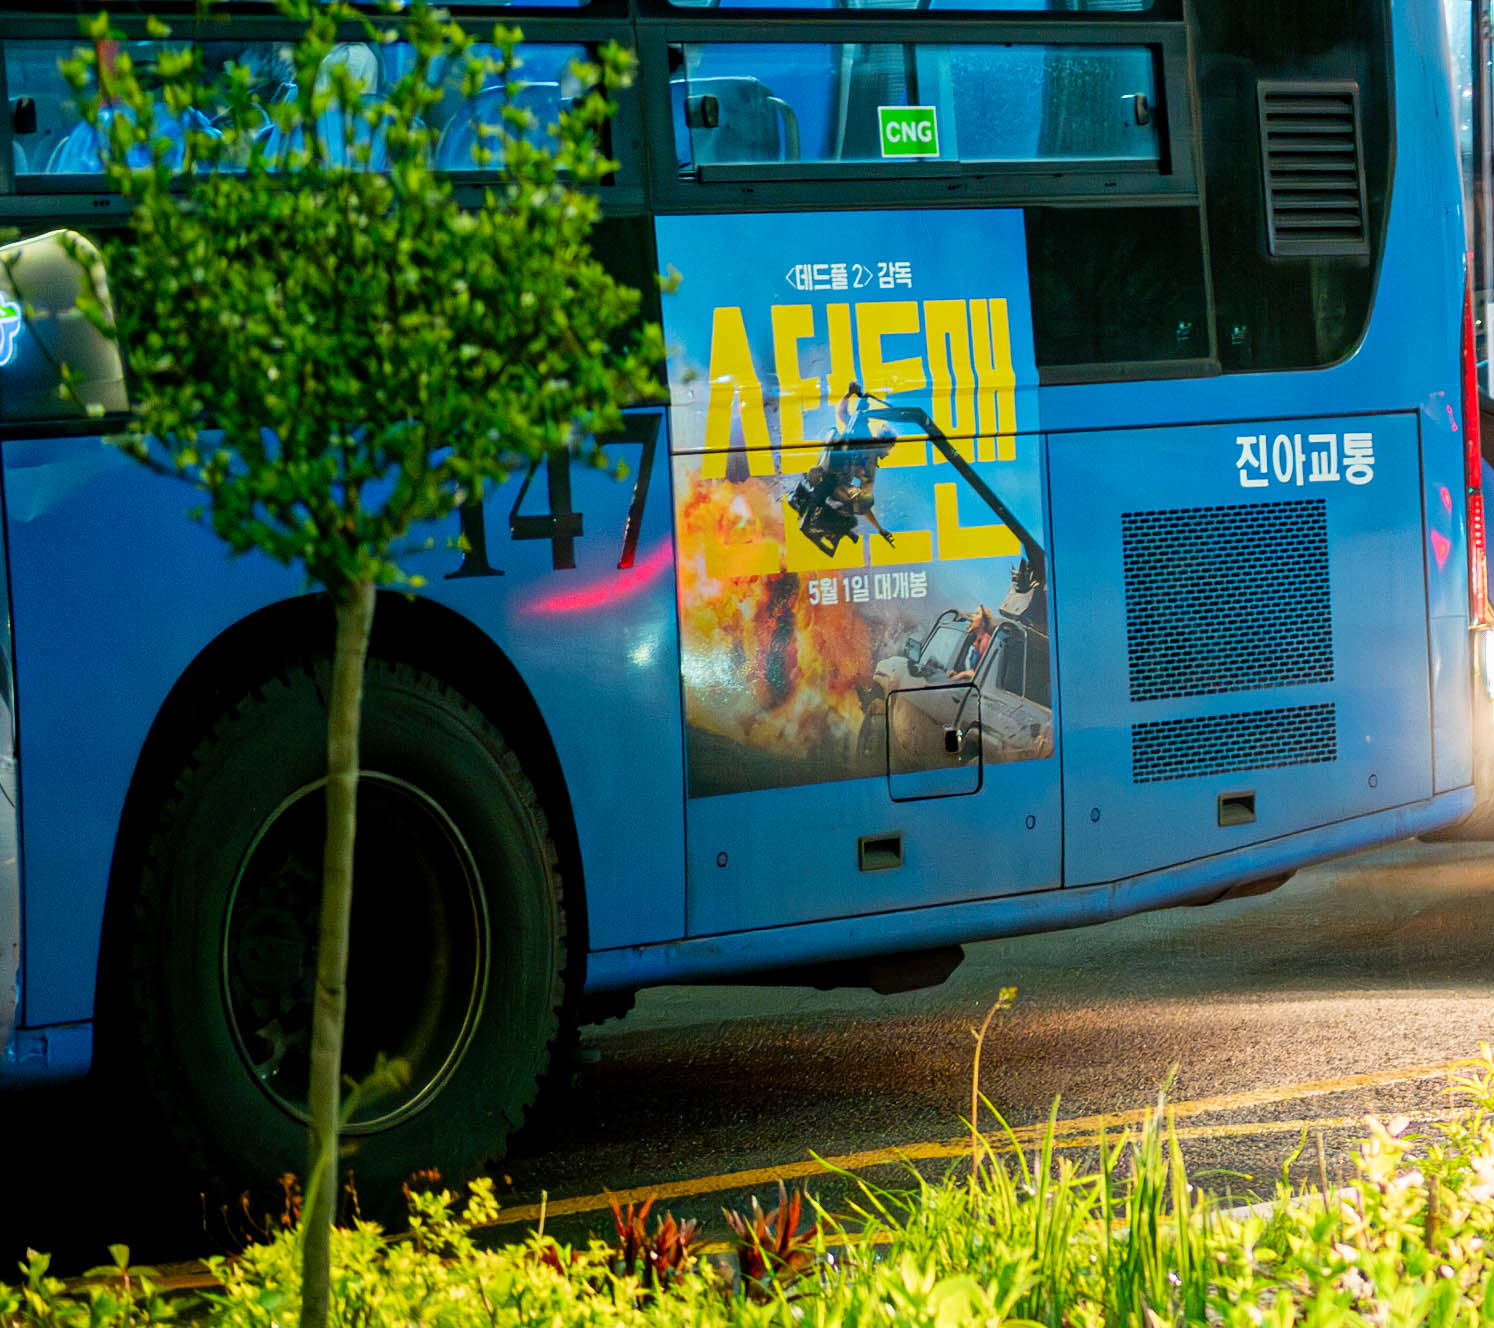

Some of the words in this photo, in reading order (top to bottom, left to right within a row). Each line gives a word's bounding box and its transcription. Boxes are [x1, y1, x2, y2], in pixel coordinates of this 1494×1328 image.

[886, 121, 932, 143] CNG
[876, 261, 913, 289] 감독
[1236, 432, 1375, 488] 진아교통
[808, 576, 839, 605] 5월
[842, 574, 870, 602] 1일
[873, 571, 928, 600] 대개봉
